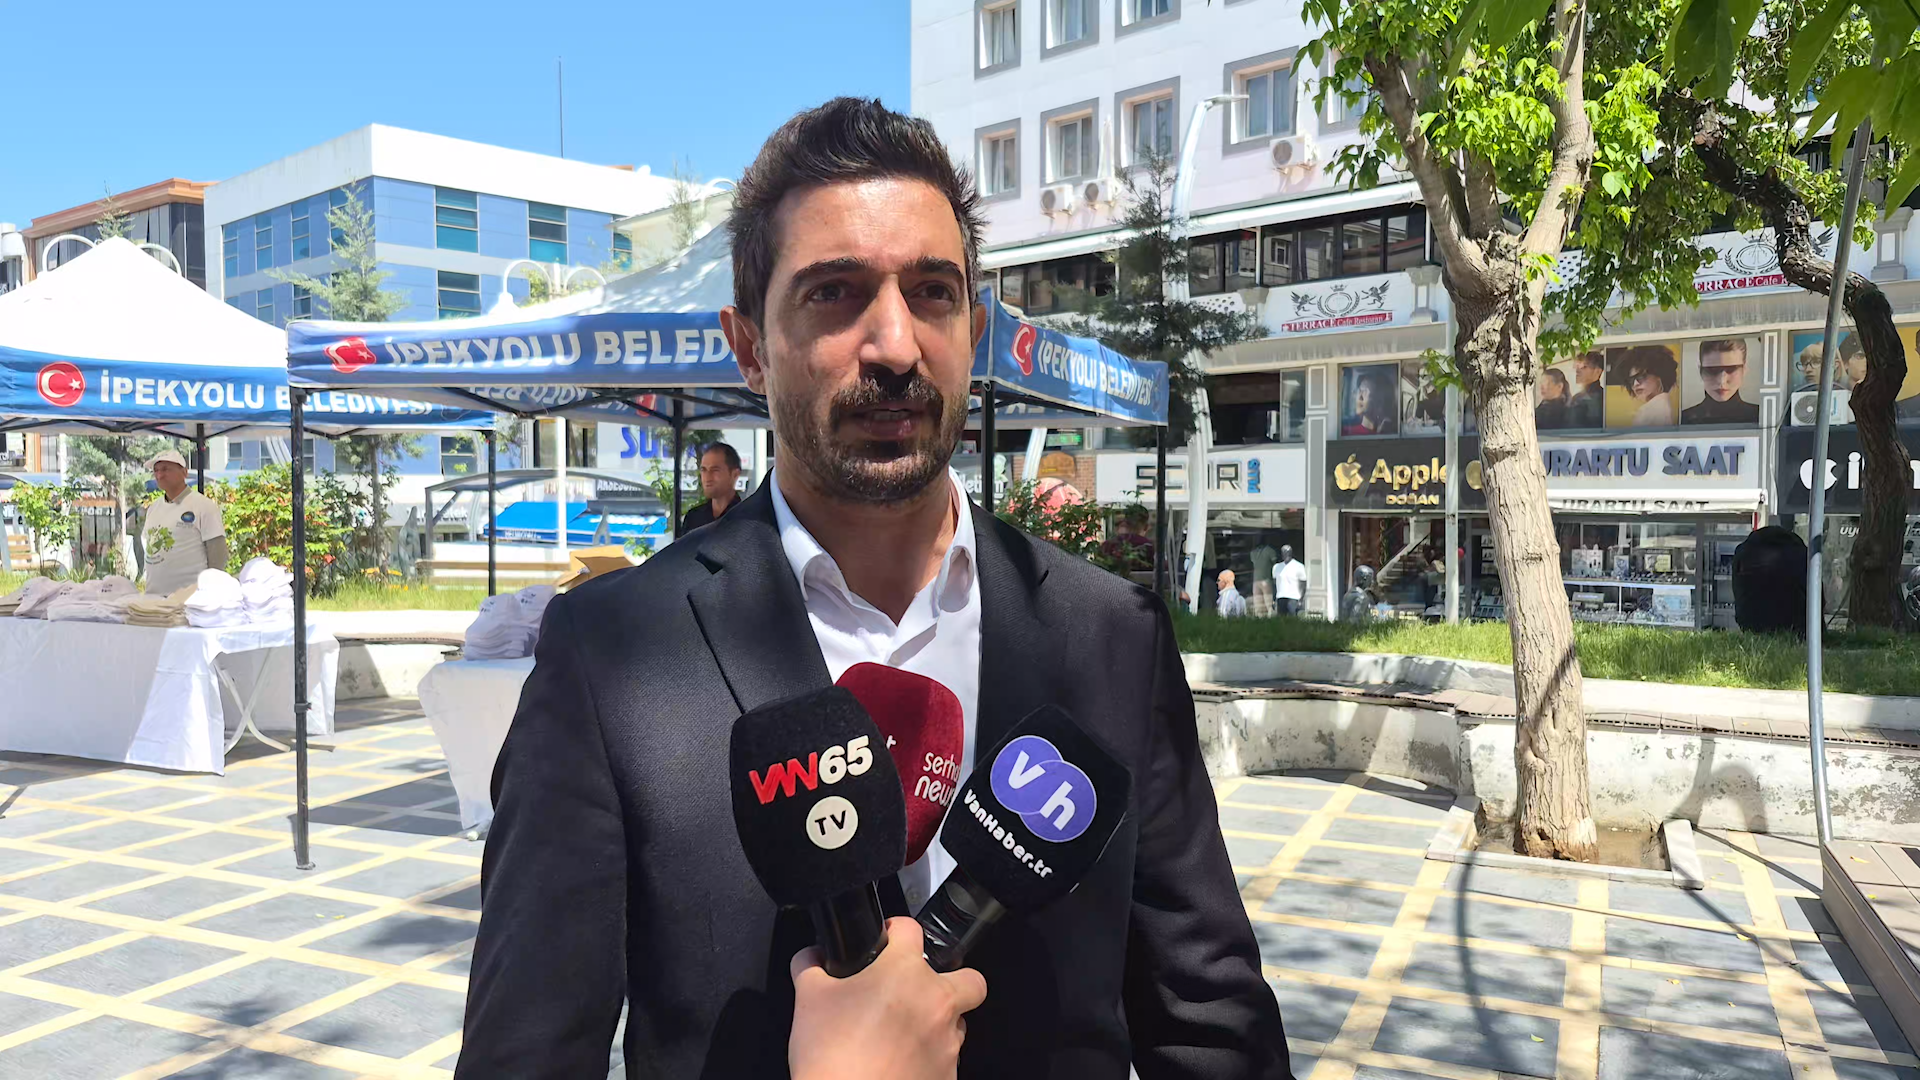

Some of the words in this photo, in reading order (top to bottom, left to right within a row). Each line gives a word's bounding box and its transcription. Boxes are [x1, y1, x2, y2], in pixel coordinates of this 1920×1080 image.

[1694, 276, 1754, 292] ERRACE
[1755, 276, 1778, 287] Cafe
[1290, 317, 1336, 331] TERRACE
[385, 333, 582, 368] İPEKYOLU
[594, 329, 737, 365] BELED
[1038, 331, 1097, 390] İPEKYOLU
[1100, 360, 1154, 406] BELEDİYESİ
[100, 369, 264, 409] İPEKYOLU
[1662, 445, 1745, 476] SAAT
[1563, 499, 1646, 511] URARTU
[1654, 500, 1710, 511] SAAT
[814, 810, 847, 836] TV
